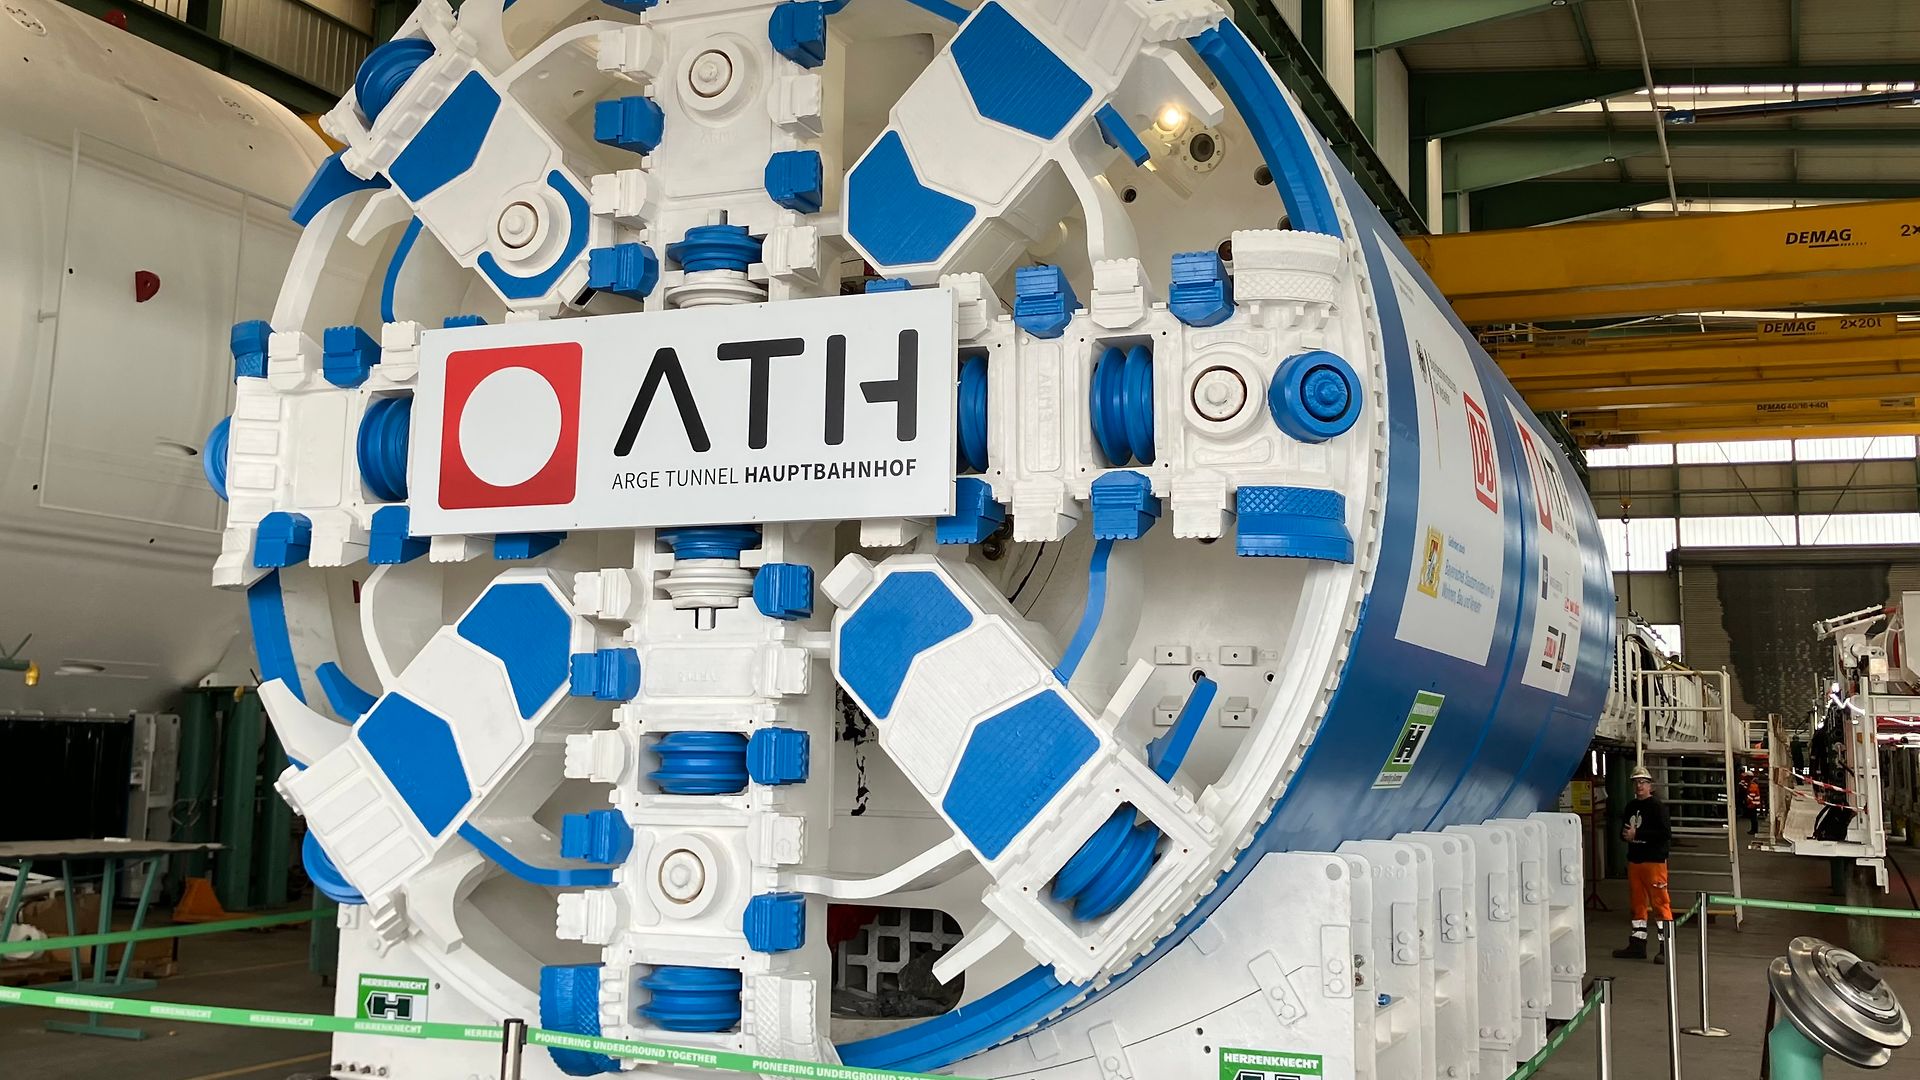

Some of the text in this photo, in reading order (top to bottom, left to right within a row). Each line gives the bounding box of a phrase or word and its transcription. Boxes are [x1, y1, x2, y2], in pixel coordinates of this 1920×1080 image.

[1785, 228, 1852, 245] DEMAG
[1763, 320, 1816, 334] DEMAG
[613, 328, 919, 457] ATH
[1468, 410, 1494, 494] DB
[611, 457, 917, 490] ARGE TUNNEL HAUPTBAHNHOF
[361, 977, 427, 991] HERRENKNECHT
[249, 1014, 315, 1027] HERRENKNECHT
[354, 1021, 423, 1034] HERRENKNECHT
[535, 1032, 717, 1065] PIONEERING UNDERGROUND TOGETHER
[752, 1059, 814, 1076] PIONEERING
[1223, 1052, 1319, 1069] HERRENKNECHT
